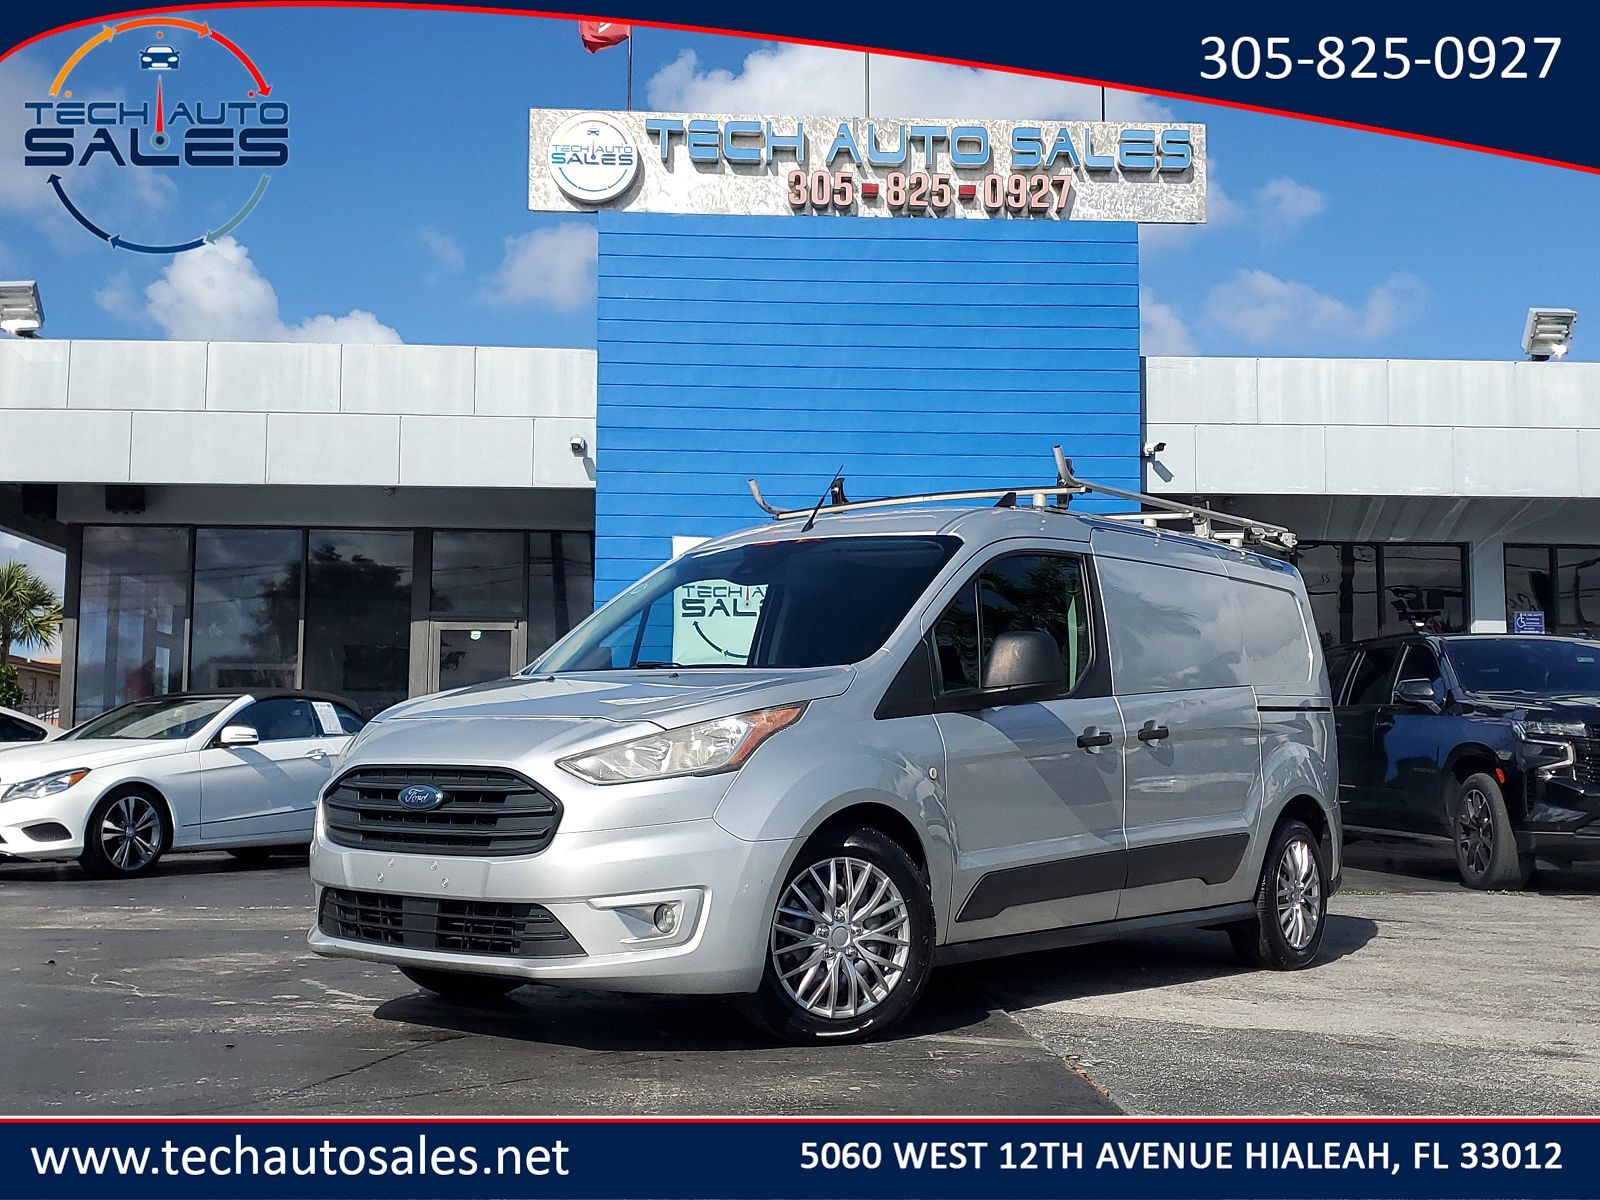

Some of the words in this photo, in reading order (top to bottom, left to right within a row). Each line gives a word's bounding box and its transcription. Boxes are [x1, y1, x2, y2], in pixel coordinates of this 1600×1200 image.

[551, 144, 589, 153] TECH
[595, 145, 633, 154] AUTO
[645, 118, 806, 163] TECH
[825, 122, 992, 168] AUTO
[1011, 126, 1193, 171] SALES
[551, 152, 634, 166] SALES
[787, 170, 1073, 213] 305-825-0927
[681, 585, 743, 598] TECH
[404, 788, 430, 804] Ford
